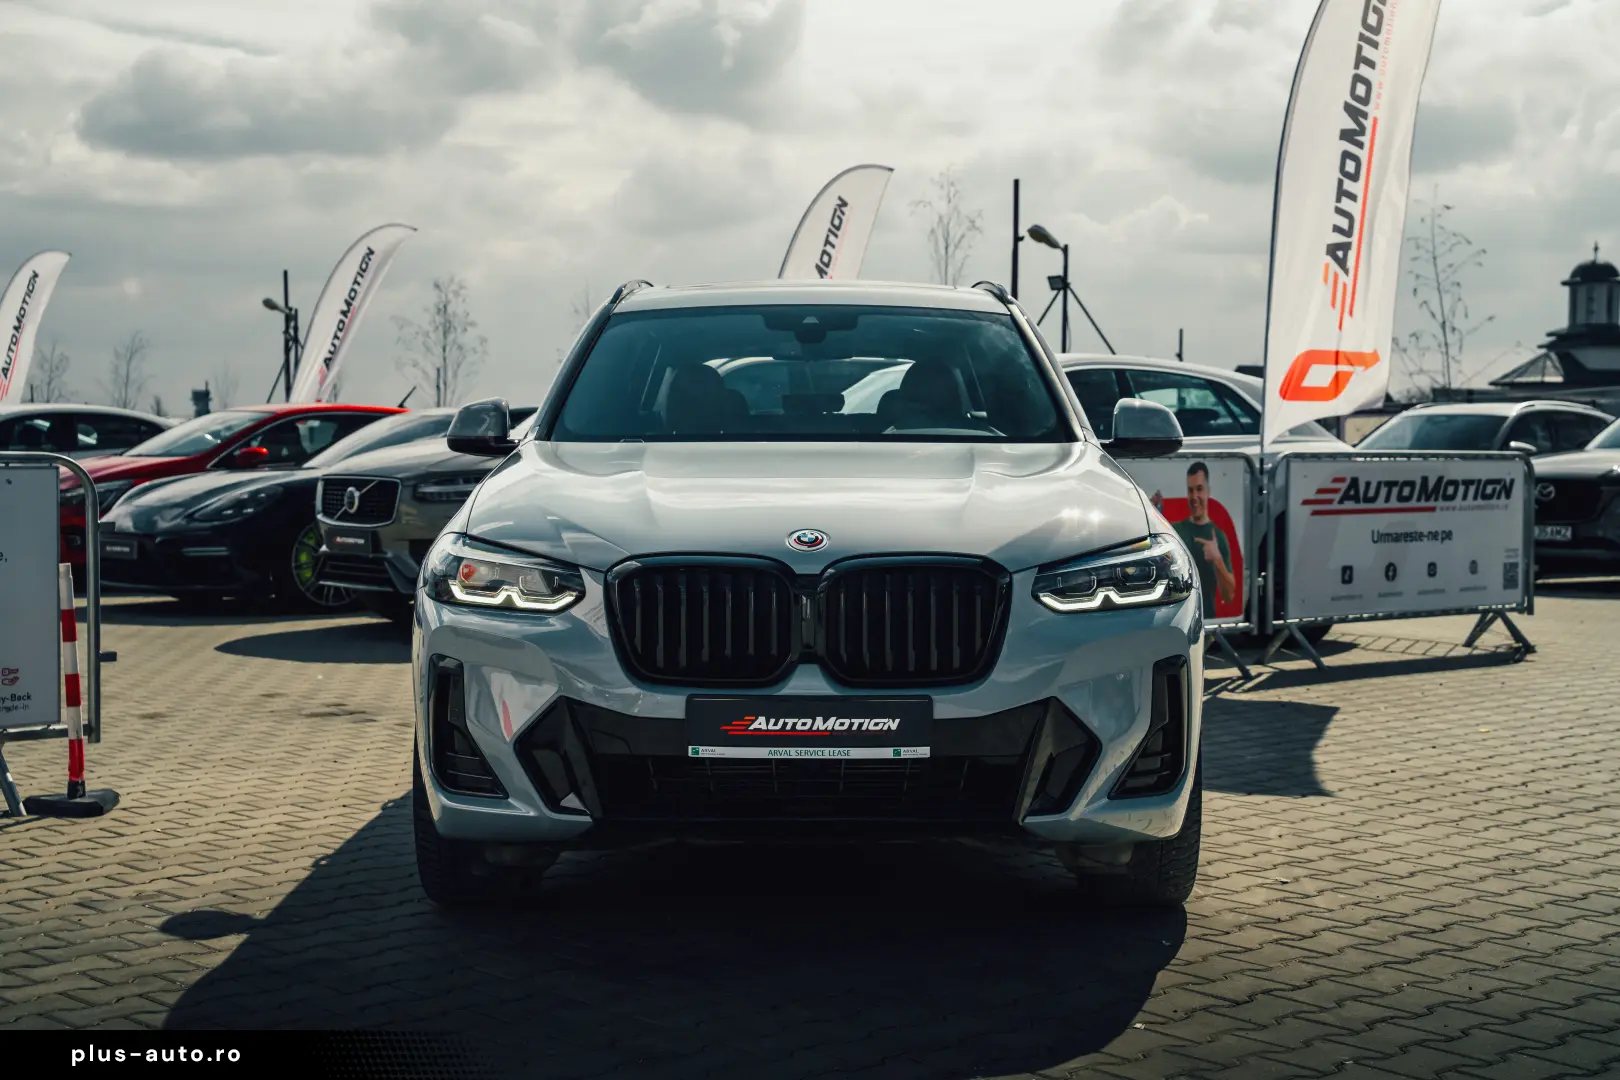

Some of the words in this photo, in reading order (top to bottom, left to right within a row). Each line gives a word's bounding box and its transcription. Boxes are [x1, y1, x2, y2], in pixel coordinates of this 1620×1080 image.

[1325, 0, 1388, 277] AUTOMOTIO
[323, 246, 375, 371] AUTOMOTION
[1, 270, 39, 380] AUTOMOTION
[1338, 476, 1515, 504] AUTOMOTION
[1440, 529, 1453, 544] pe
[748, 716, 901, 731] AUTOMOTION
[767, 749, 793, 757] ARVAL
[794, 749, 827, 757] SERVICE
[828, 749, 852, 757] LEASE
